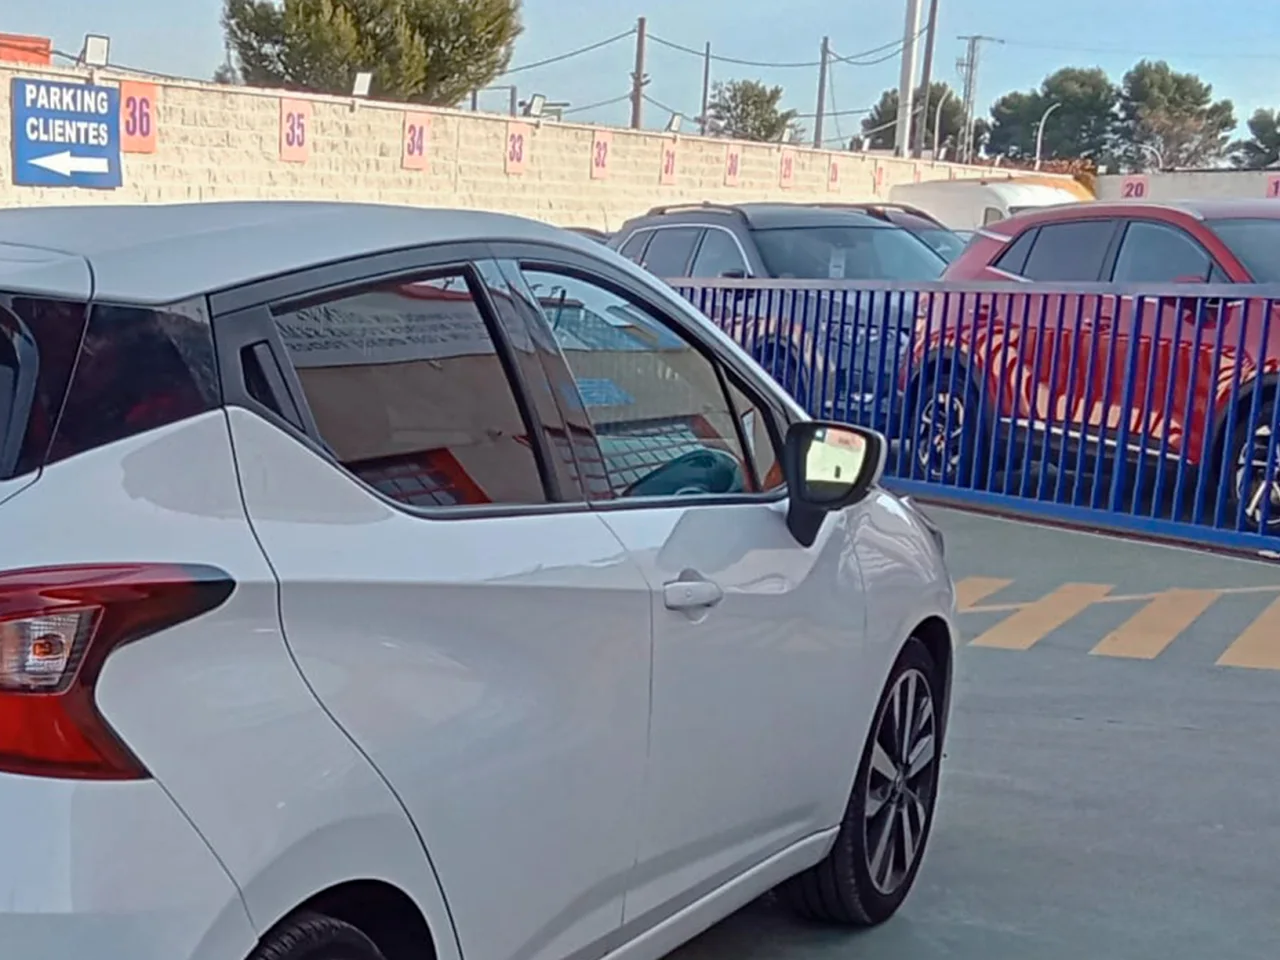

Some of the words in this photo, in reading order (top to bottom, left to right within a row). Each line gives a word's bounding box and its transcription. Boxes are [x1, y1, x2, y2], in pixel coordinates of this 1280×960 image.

[24, 84, 109, 115] PARKING
[25, 117, 109, 146] CLIENTES
[125, 96, 150, 137] 36
[285, 113, 305, 148] 35
[407, 124, 424, 156] 34
[508, 133, 523, 163] 33
[594, 140, 608, 168] 32
[664, 149, 676, 176] 31
[1125, 182, 1144, 198] 20
